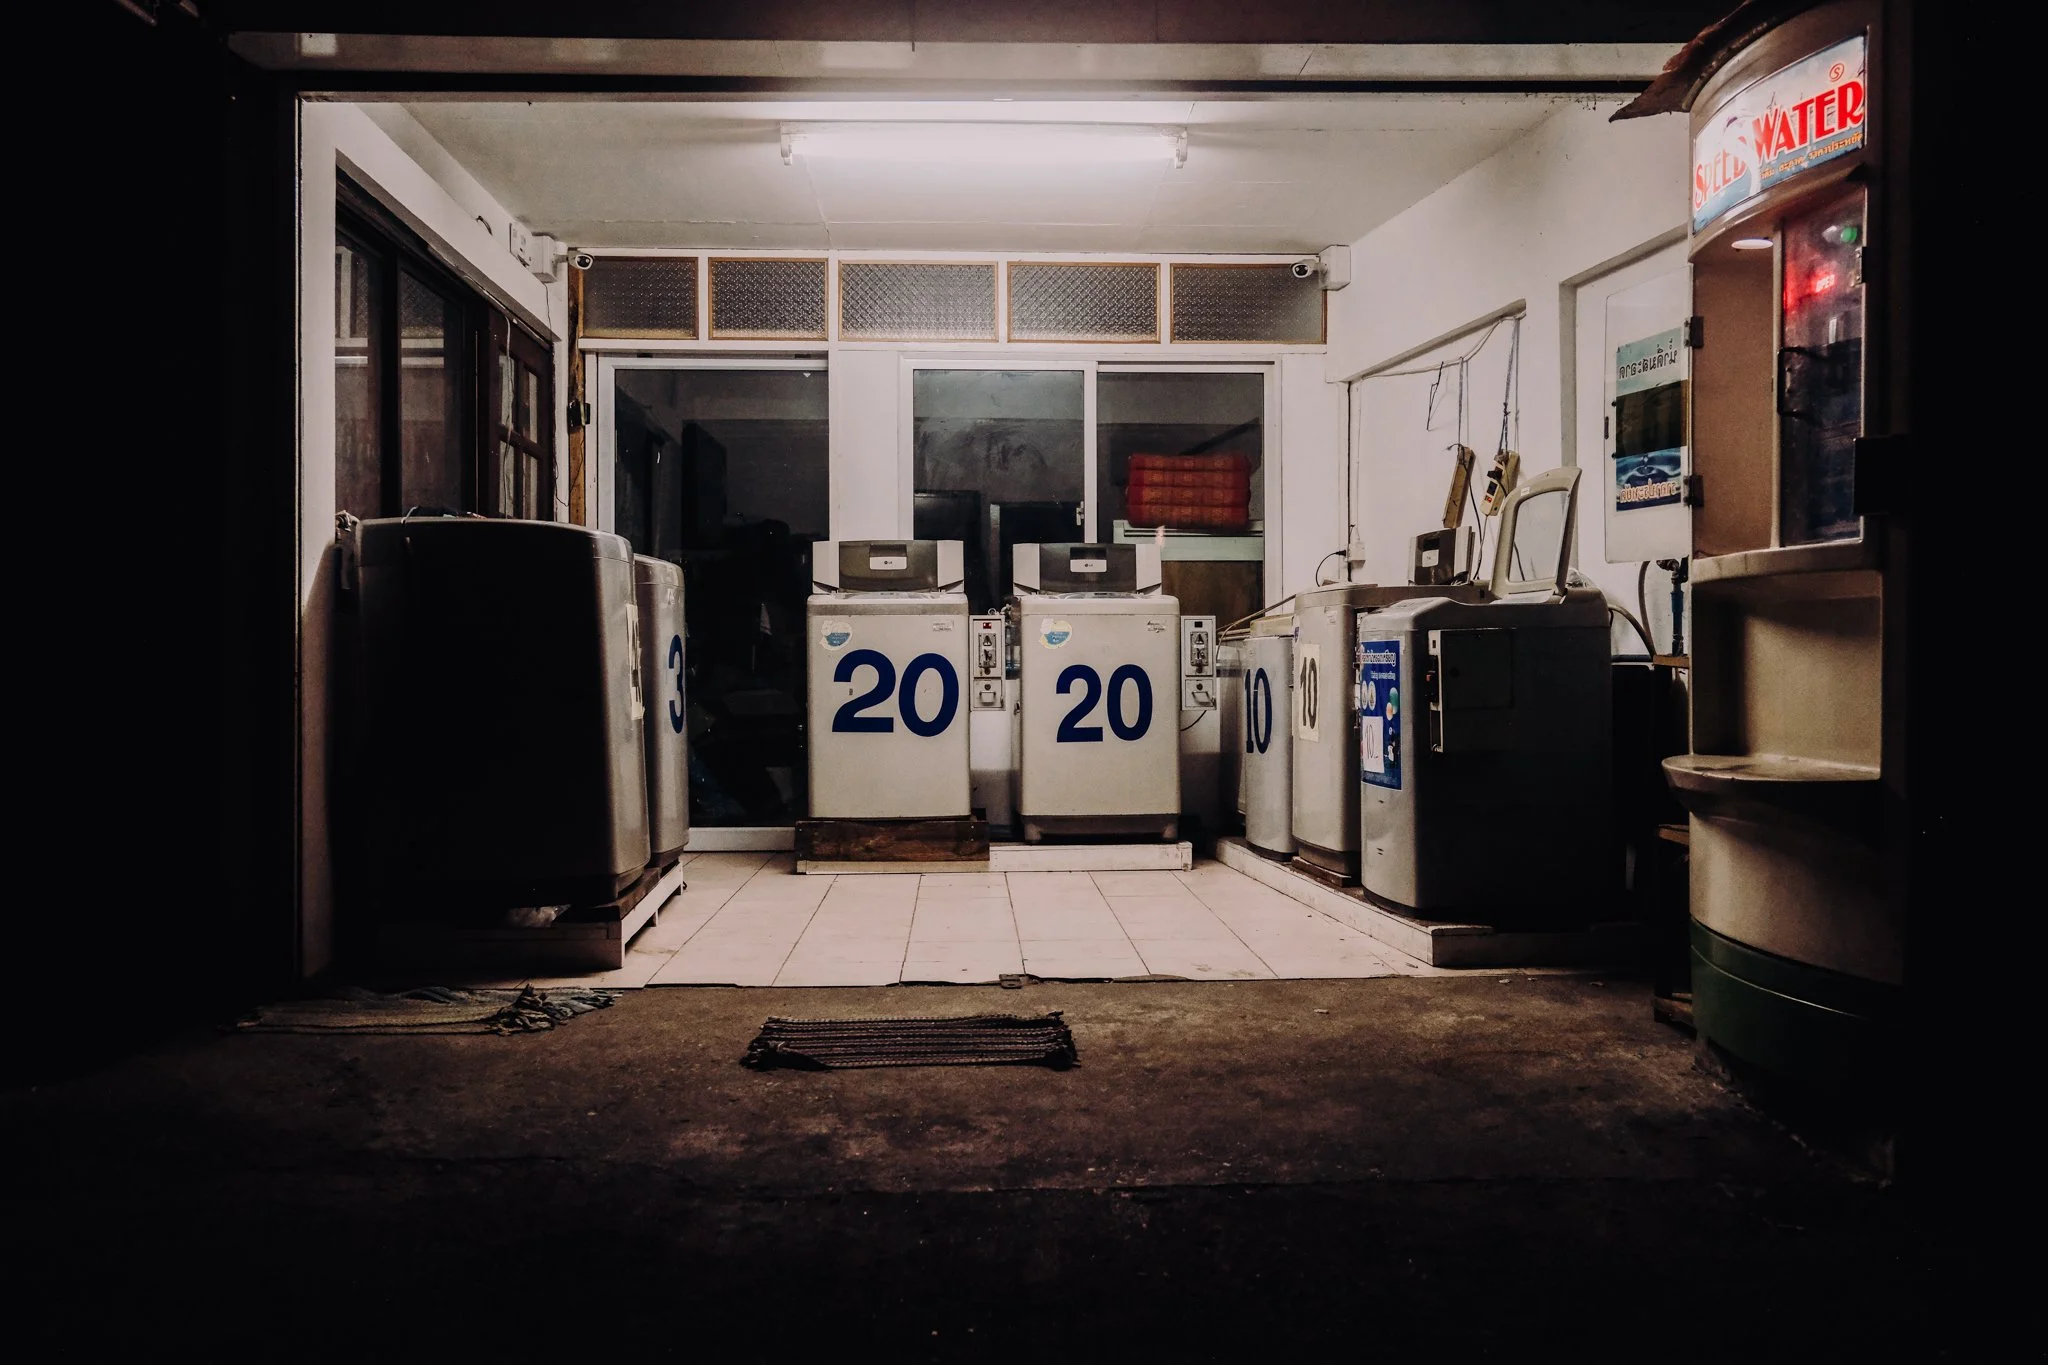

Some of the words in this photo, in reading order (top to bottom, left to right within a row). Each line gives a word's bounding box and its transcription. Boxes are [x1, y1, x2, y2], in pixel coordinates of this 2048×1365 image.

[1752, 81, 1864, 161] WATER
[831, 648, 960, 738] 20
[1055, 663, 1153, 743] 20
[1244, 667, 1273, 755] 10
[1300, 656, 1318, 730] 10
